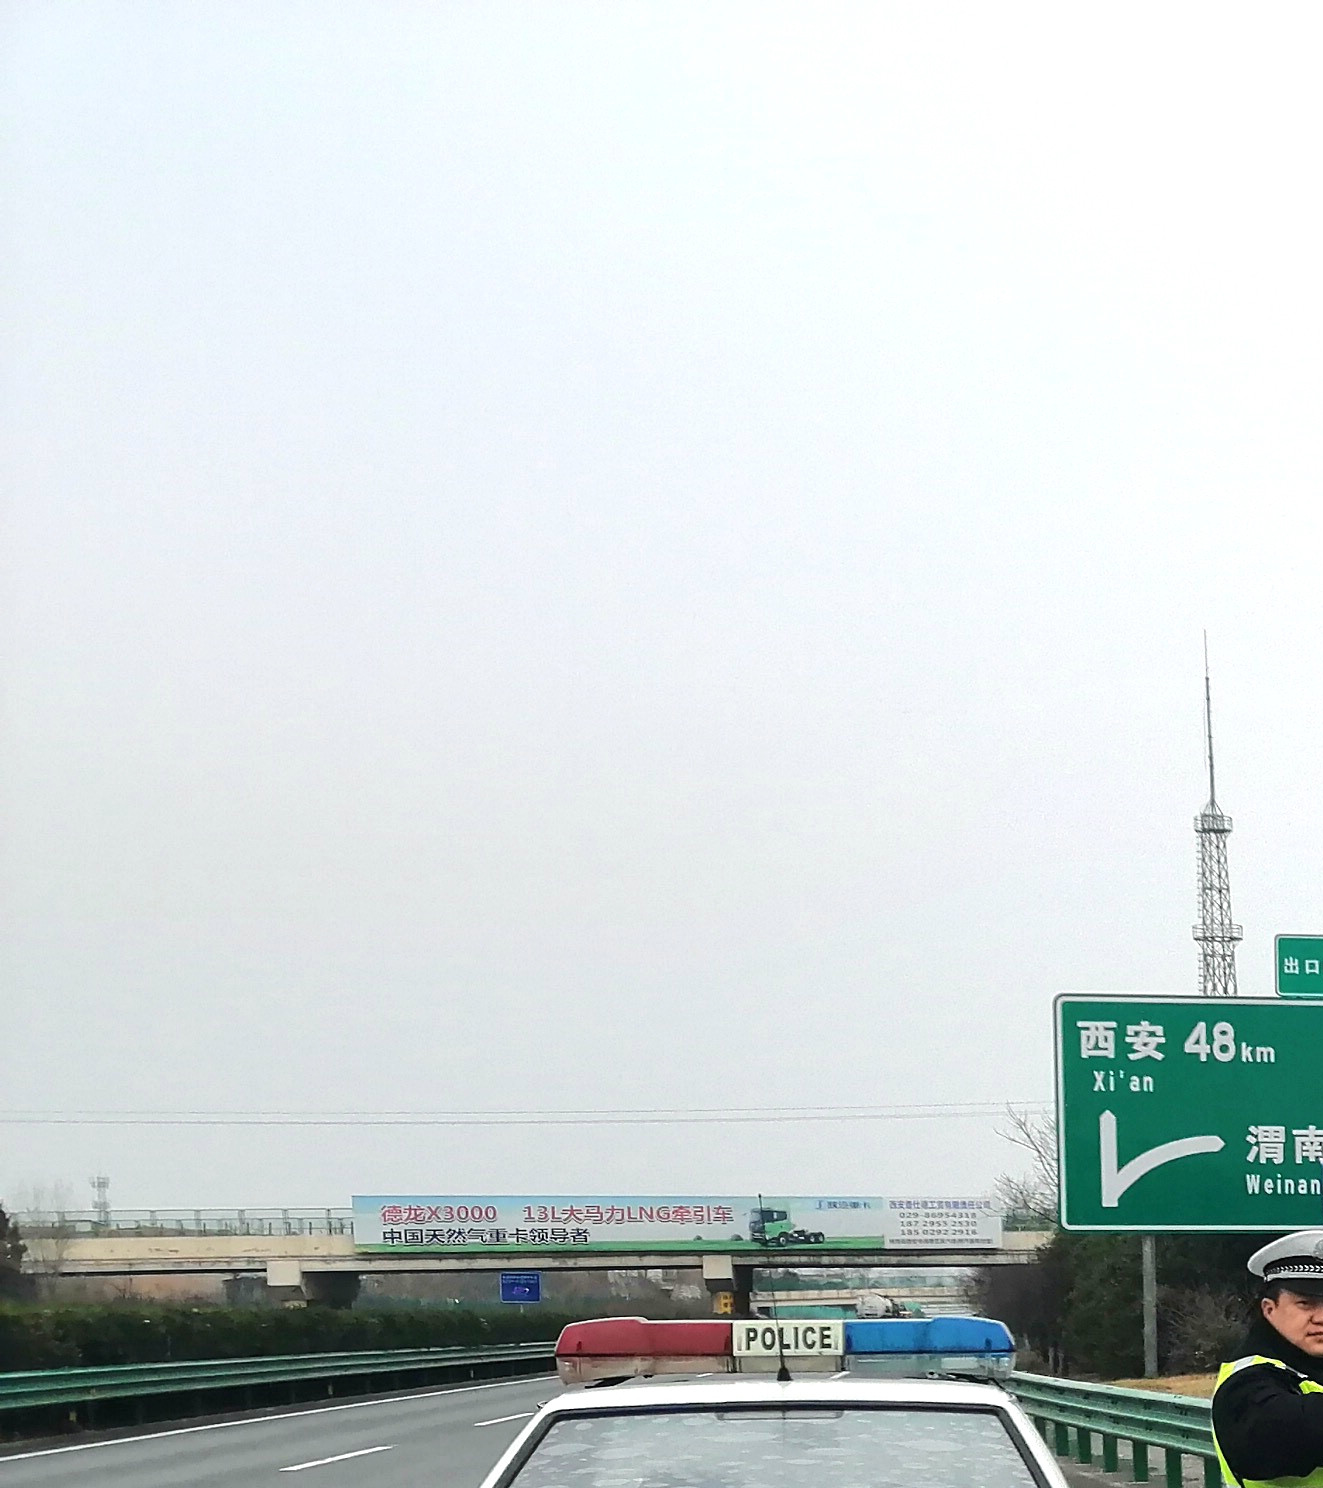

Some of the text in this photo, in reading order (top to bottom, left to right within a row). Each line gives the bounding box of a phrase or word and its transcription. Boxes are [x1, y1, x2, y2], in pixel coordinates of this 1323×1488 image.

[1283, 956, 1320, 975] 出口
[1076, 1020, 1166, 1061] 西安
[1093, 1070, 1154, 1092] Xi'an
[1245, 1173, 1321, 1195] Weinan
[381, 1205, 498, 1224] 德龙X3000
[382, 1228, 590, 1245] 中国天然气重卡领导者
[745, 1326, 832, 1351] POLICE
